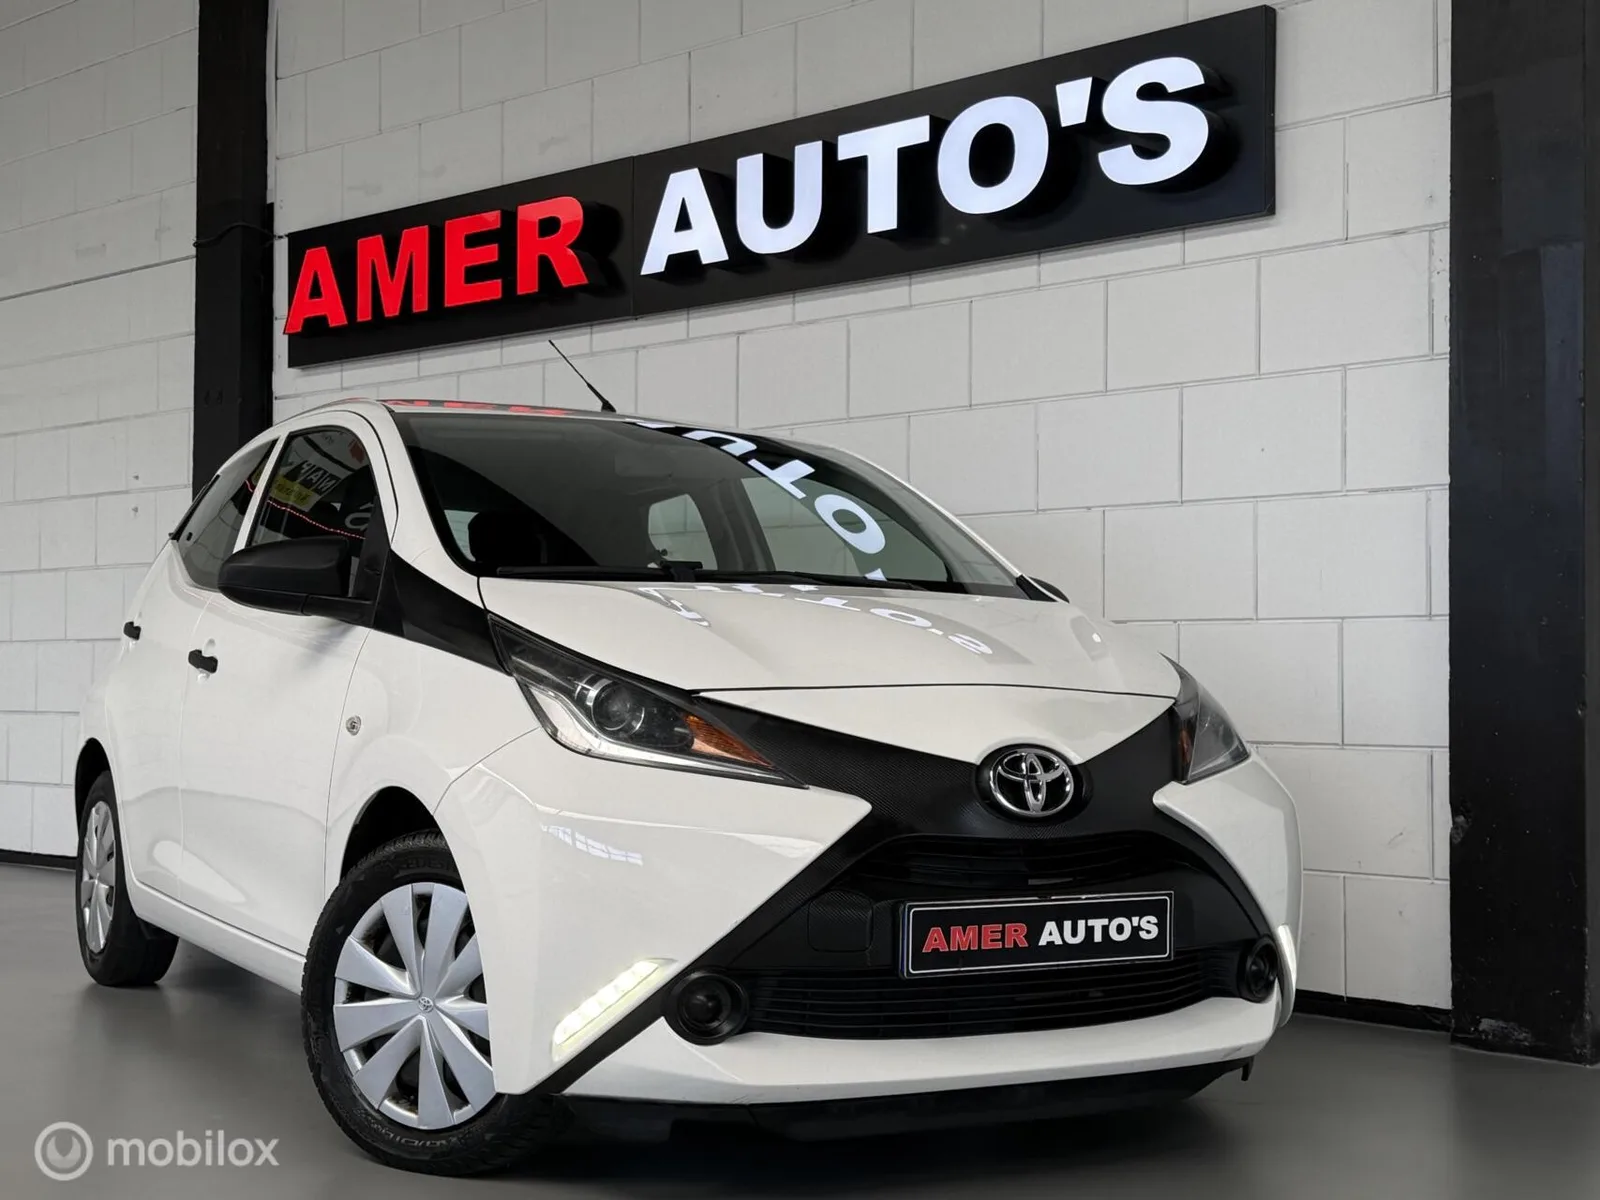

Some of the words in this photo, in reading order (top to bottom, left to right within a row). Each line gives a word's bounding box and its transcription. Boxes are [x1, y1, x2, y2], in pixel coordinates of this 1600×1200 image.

[284, 196, 589, 335] AMER
[640, 56, 1209, 276] AUTO'S
[922, 923, 1029, 953] AMER
[1038, 915, 1159, 946] AUTO'S
